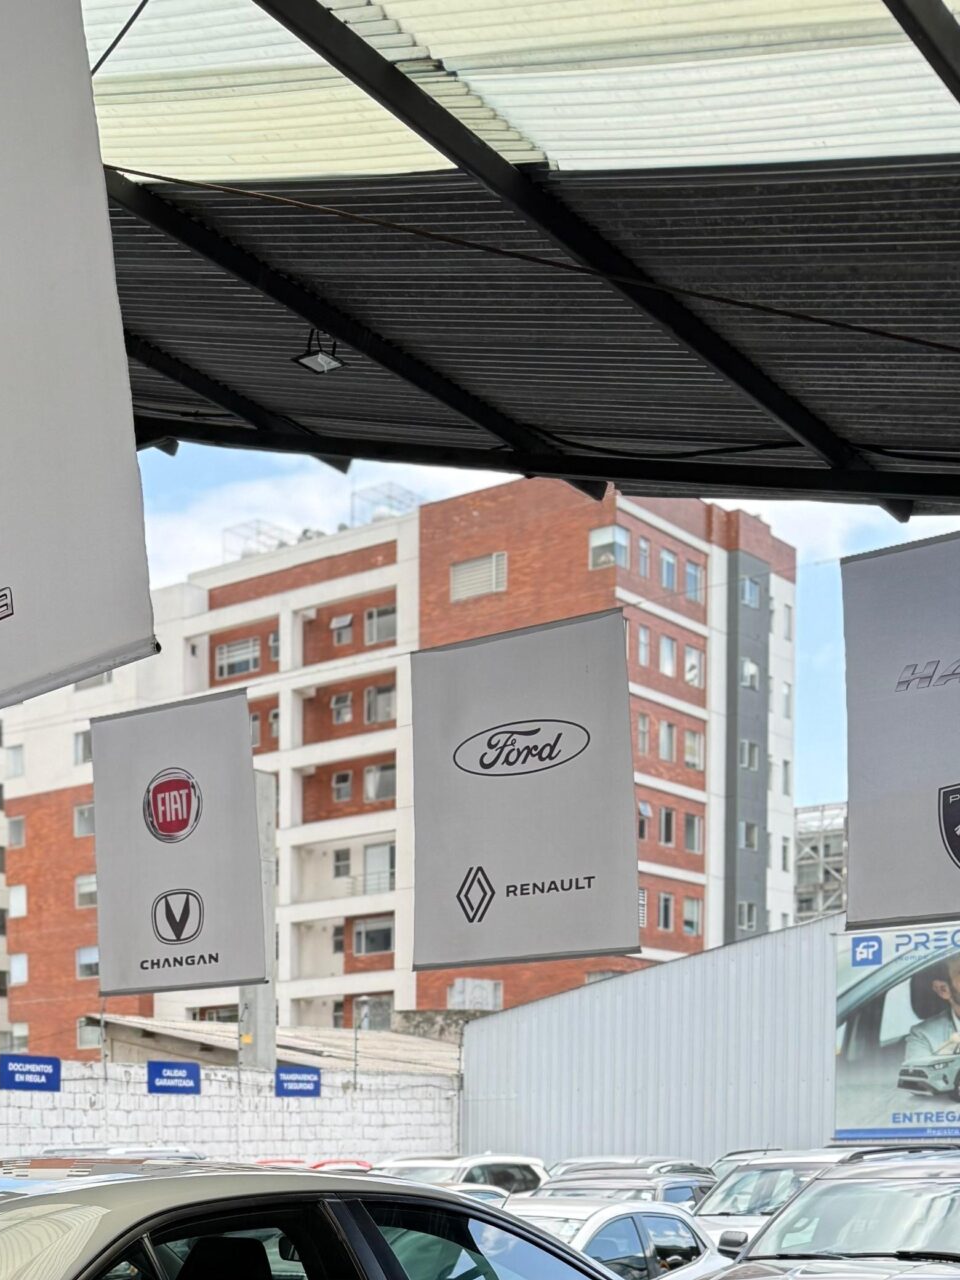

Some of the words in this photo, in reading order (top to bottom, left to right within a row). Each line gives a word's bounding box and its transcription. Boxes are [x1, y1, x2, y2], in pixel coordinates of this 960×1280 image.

[479, 727, 563, 770] Ford
[156, 789, 190, 823] FIAT
[506, 876, 596, 897] RENAULT
[140, 952, 219, 970] CHANGAN
[8, 1061, 53, 1074] DOCUMENTOS
